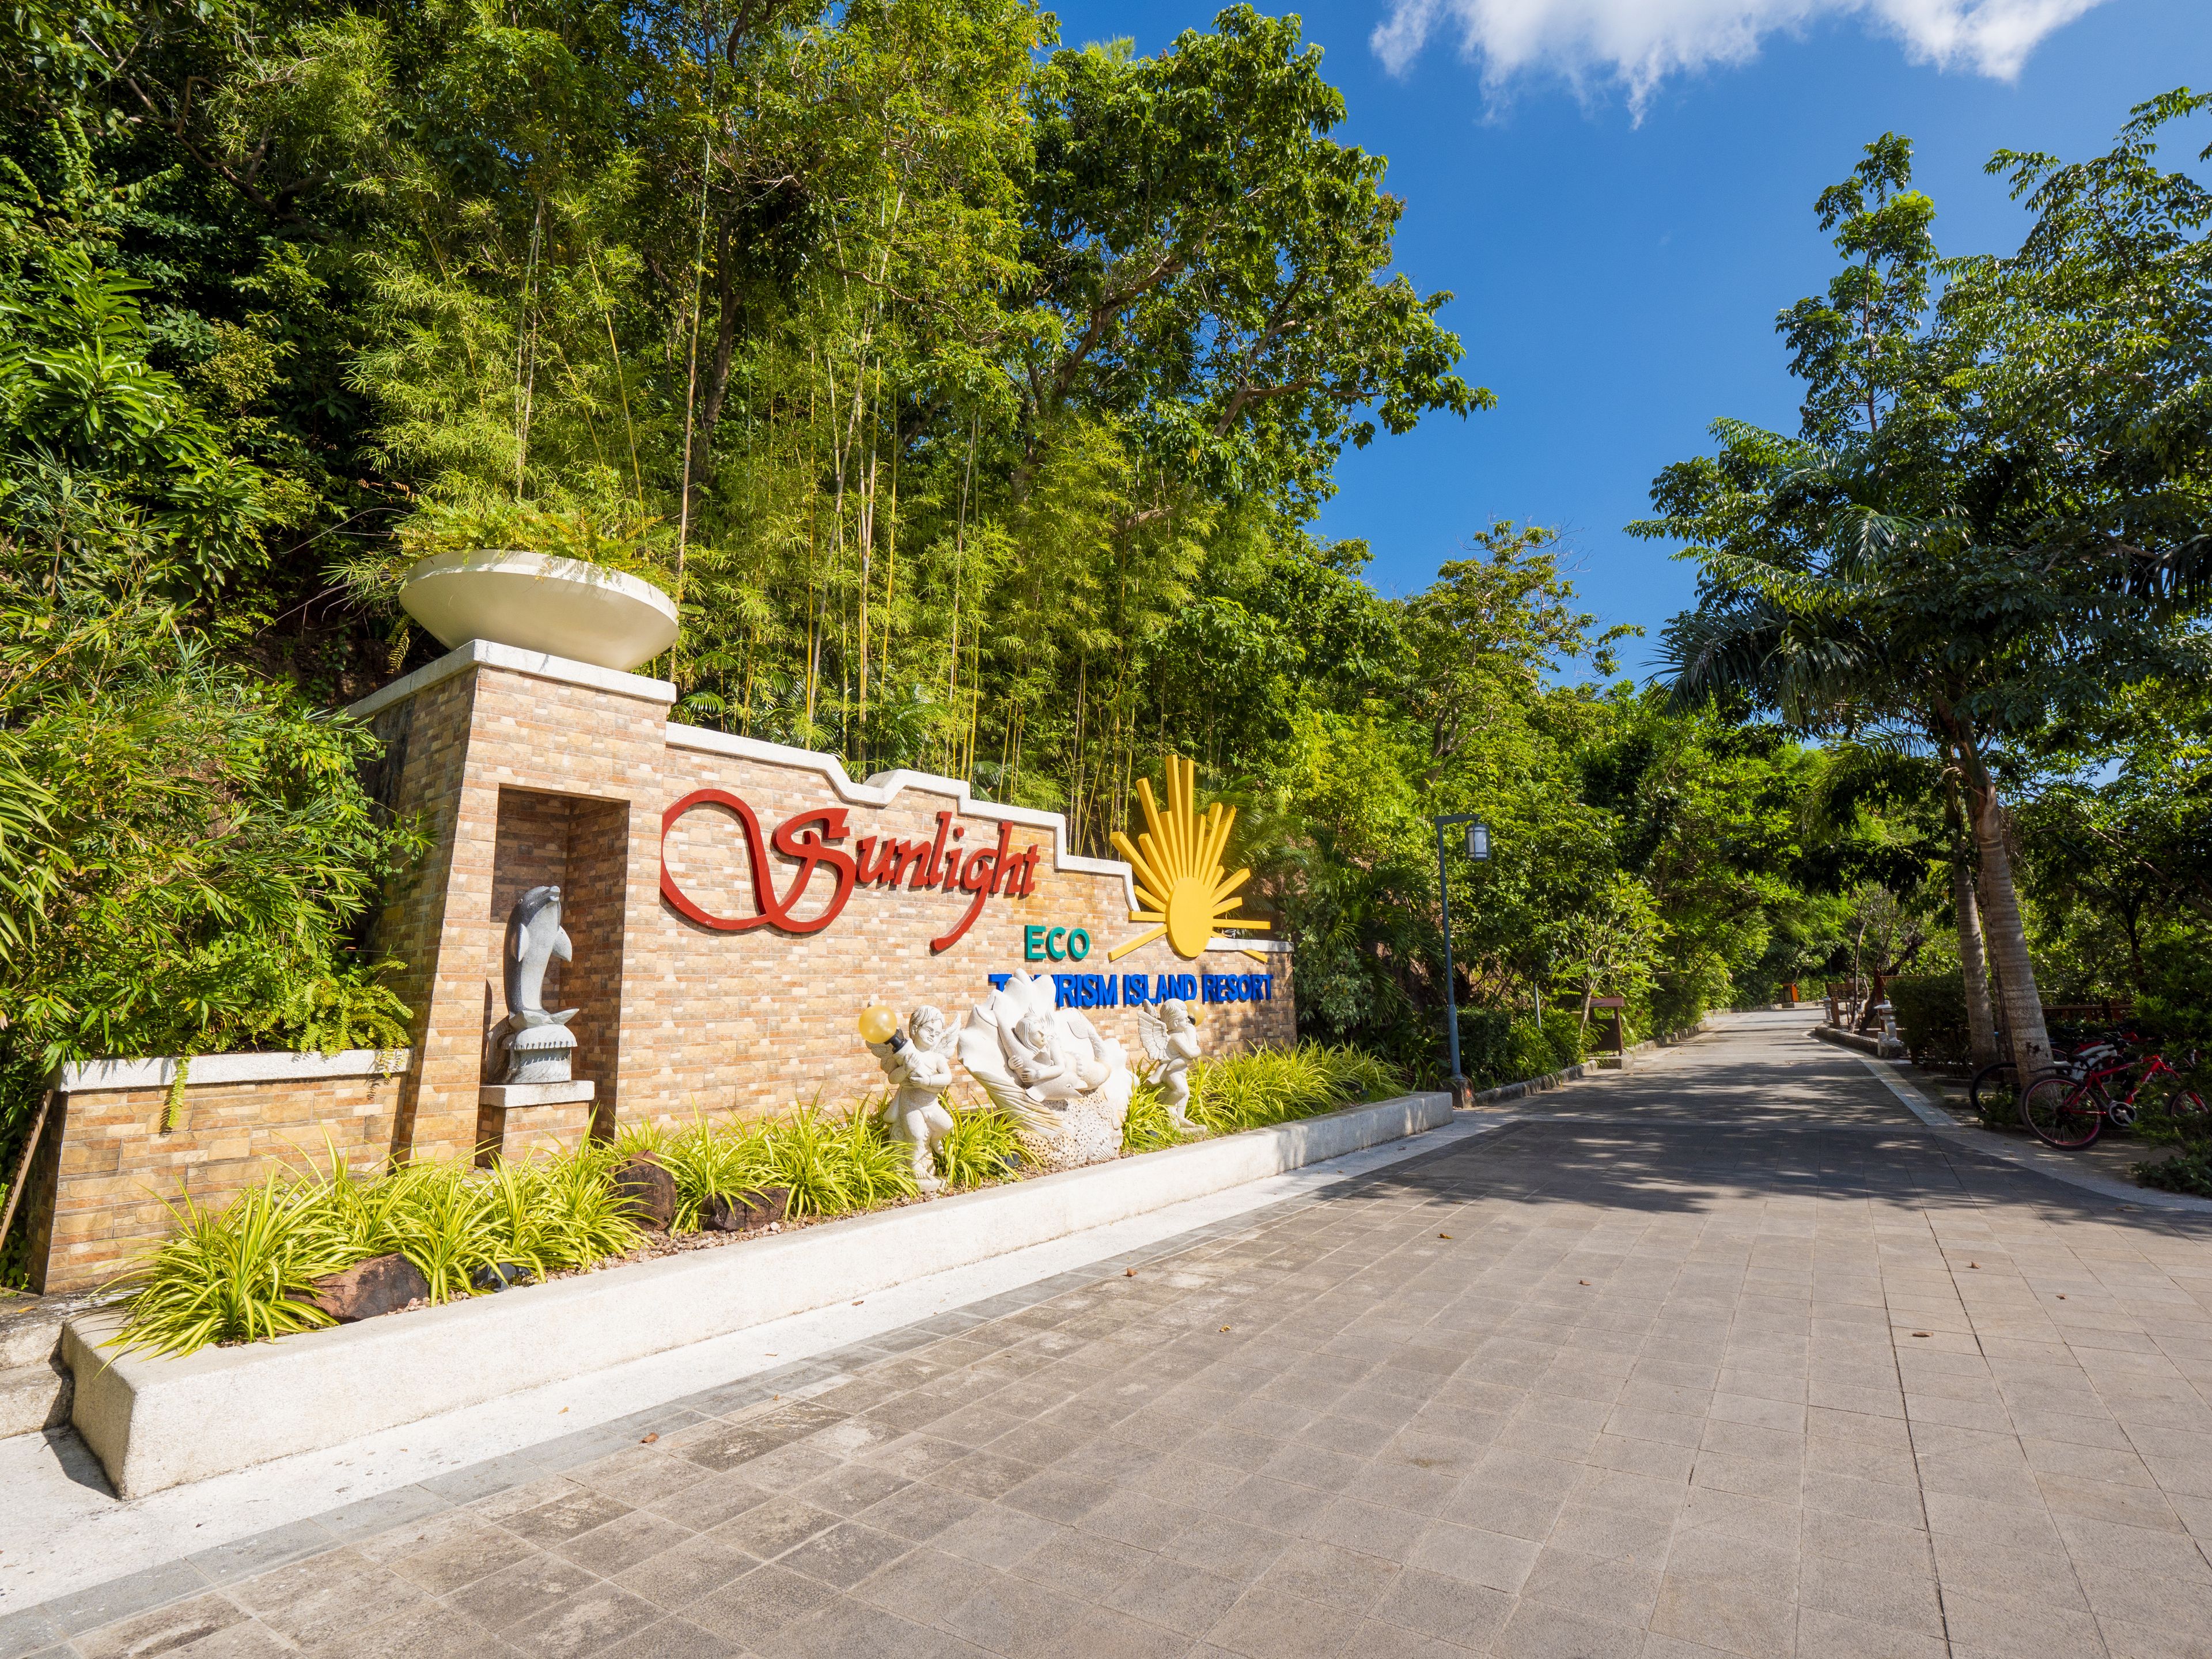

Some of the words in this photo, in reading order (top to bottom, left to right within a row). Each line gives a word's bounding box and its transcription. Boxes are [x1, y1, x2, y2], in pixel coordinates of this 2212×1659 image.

[660, 789, 1040, 955] Sunlight
[1024, 925, 1090, 960] ECO
[988, 974, 1118, 1008] TRISM
[1123, 974, 1198, 1006] ISLAND
[1202, 974, 1274, 1004] RESORT
